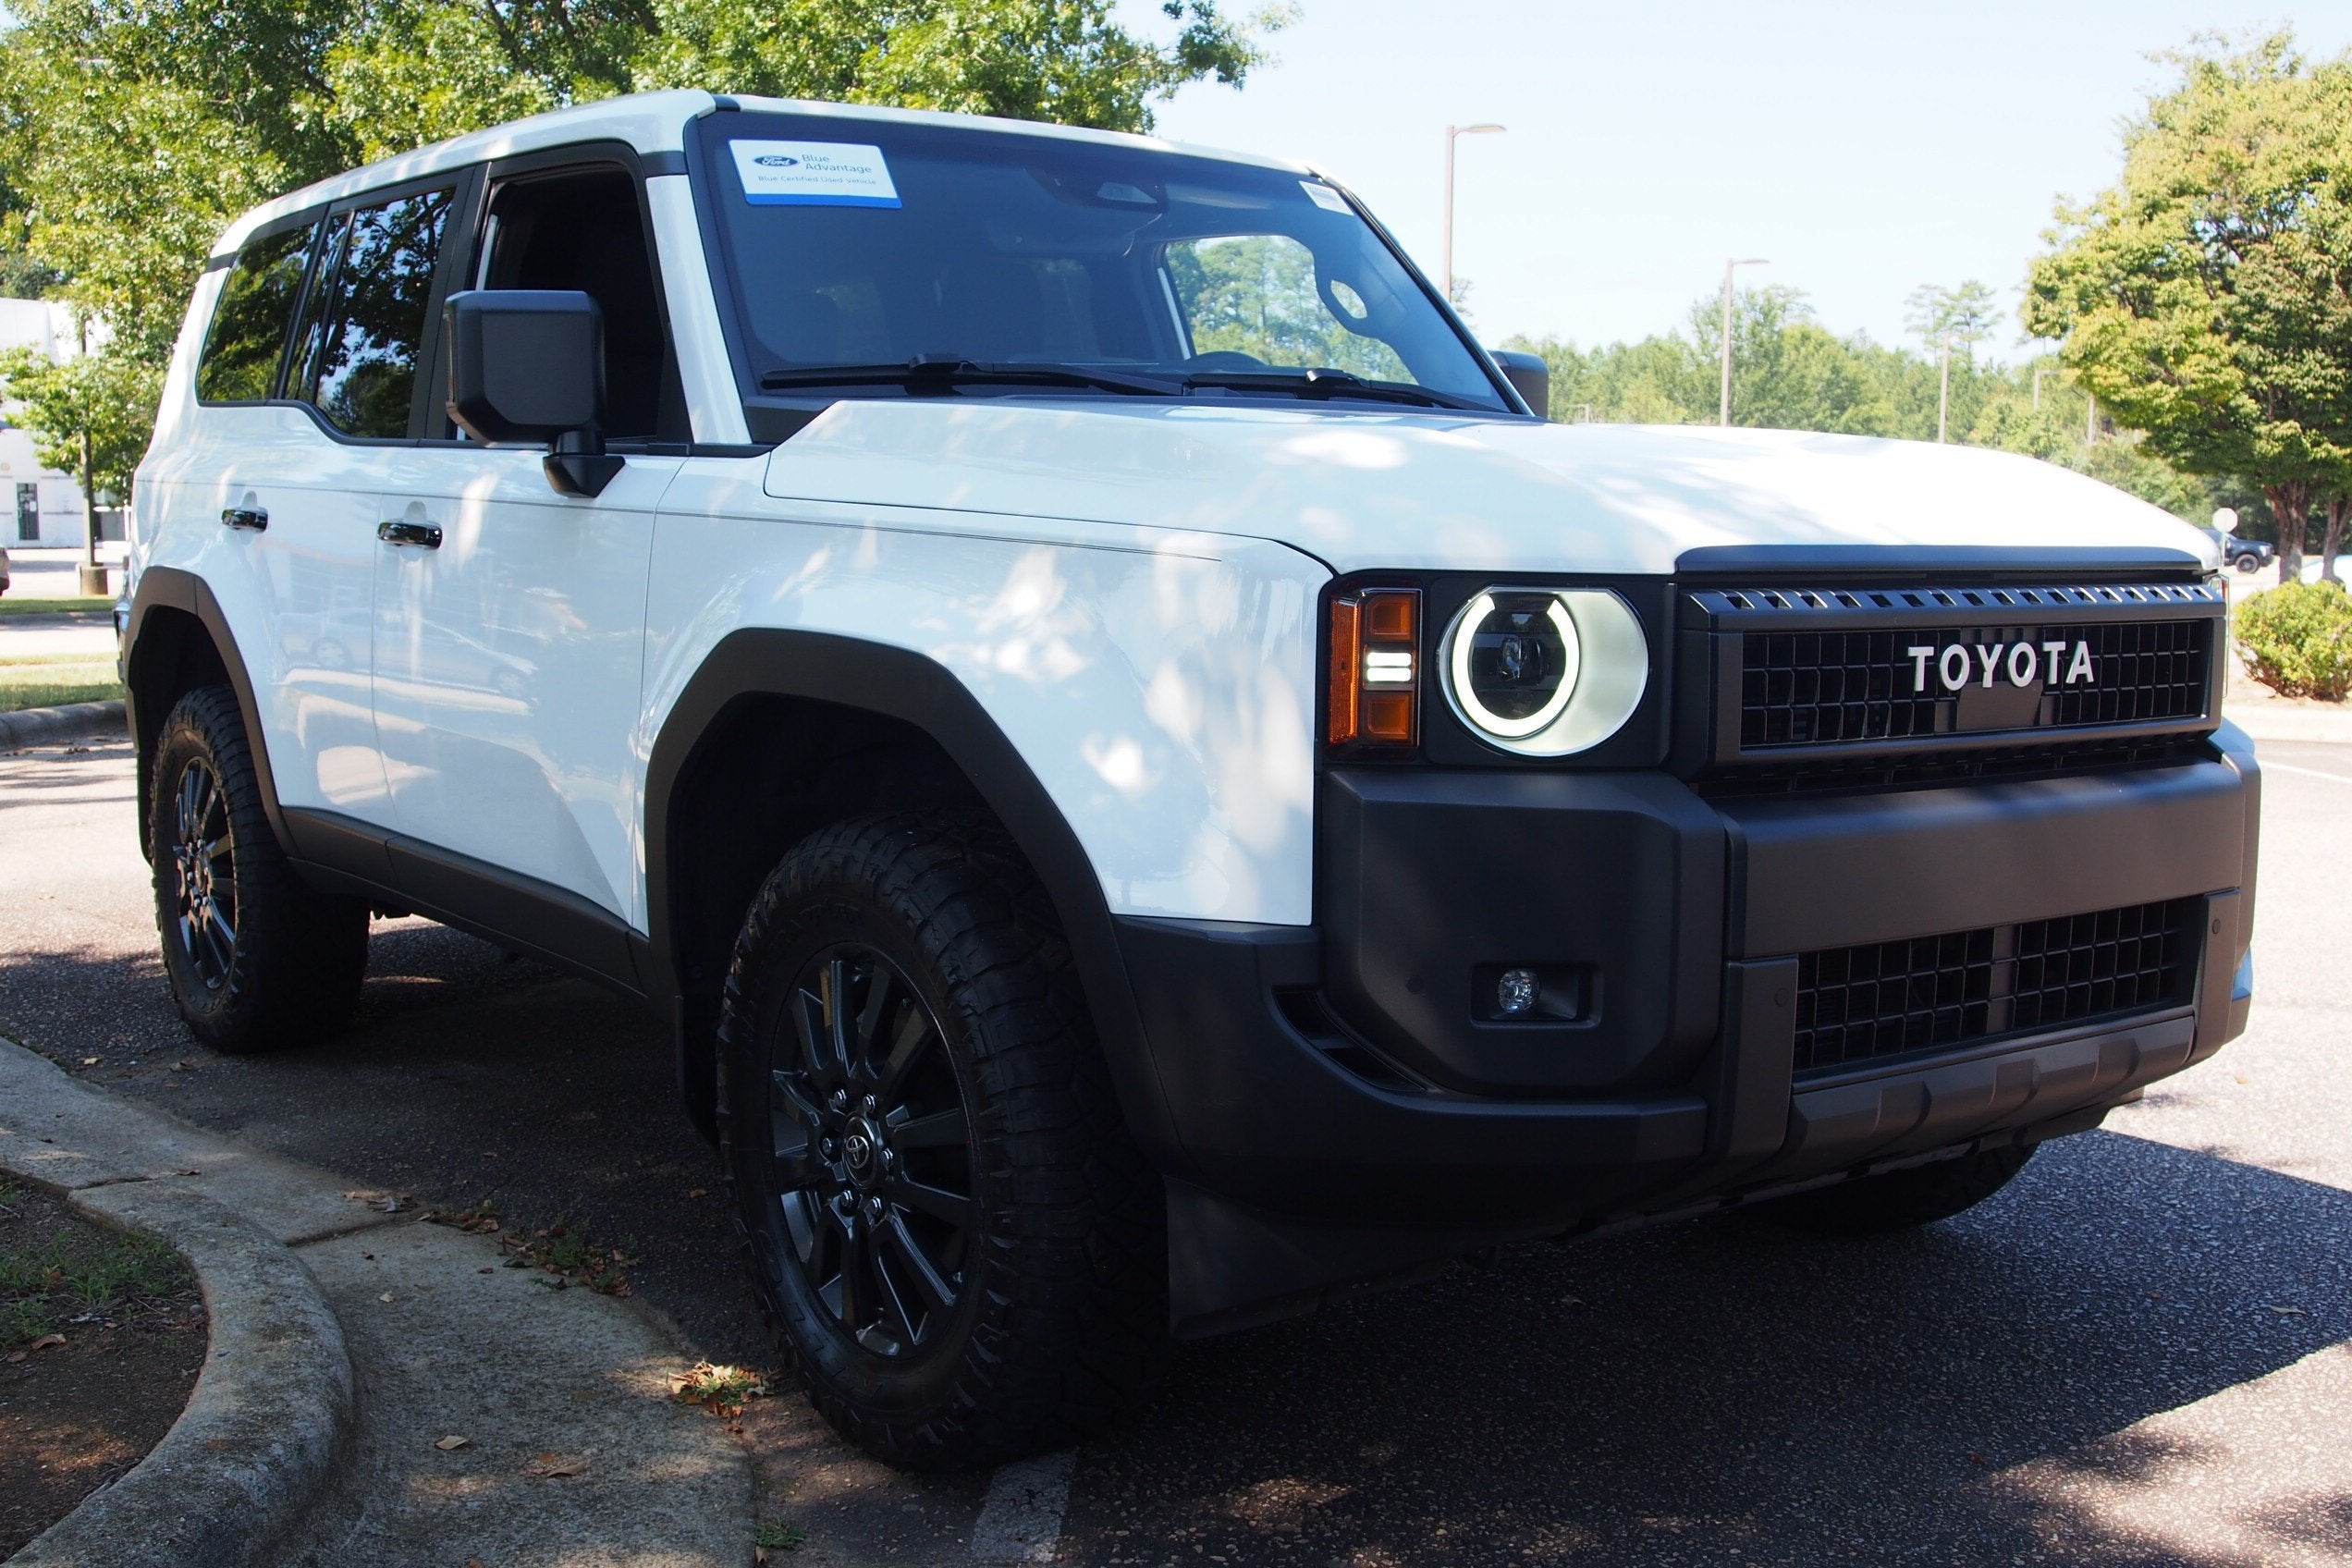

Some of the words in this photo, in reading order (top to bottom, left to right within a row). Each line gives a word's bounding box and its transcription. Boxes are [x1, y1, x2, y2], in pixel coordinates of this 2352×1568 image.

[802, 154, 830, 163] Blue
[805, 163, 872, 174] Advantage
[1907, 641, 2094, 692] TOYOTA
